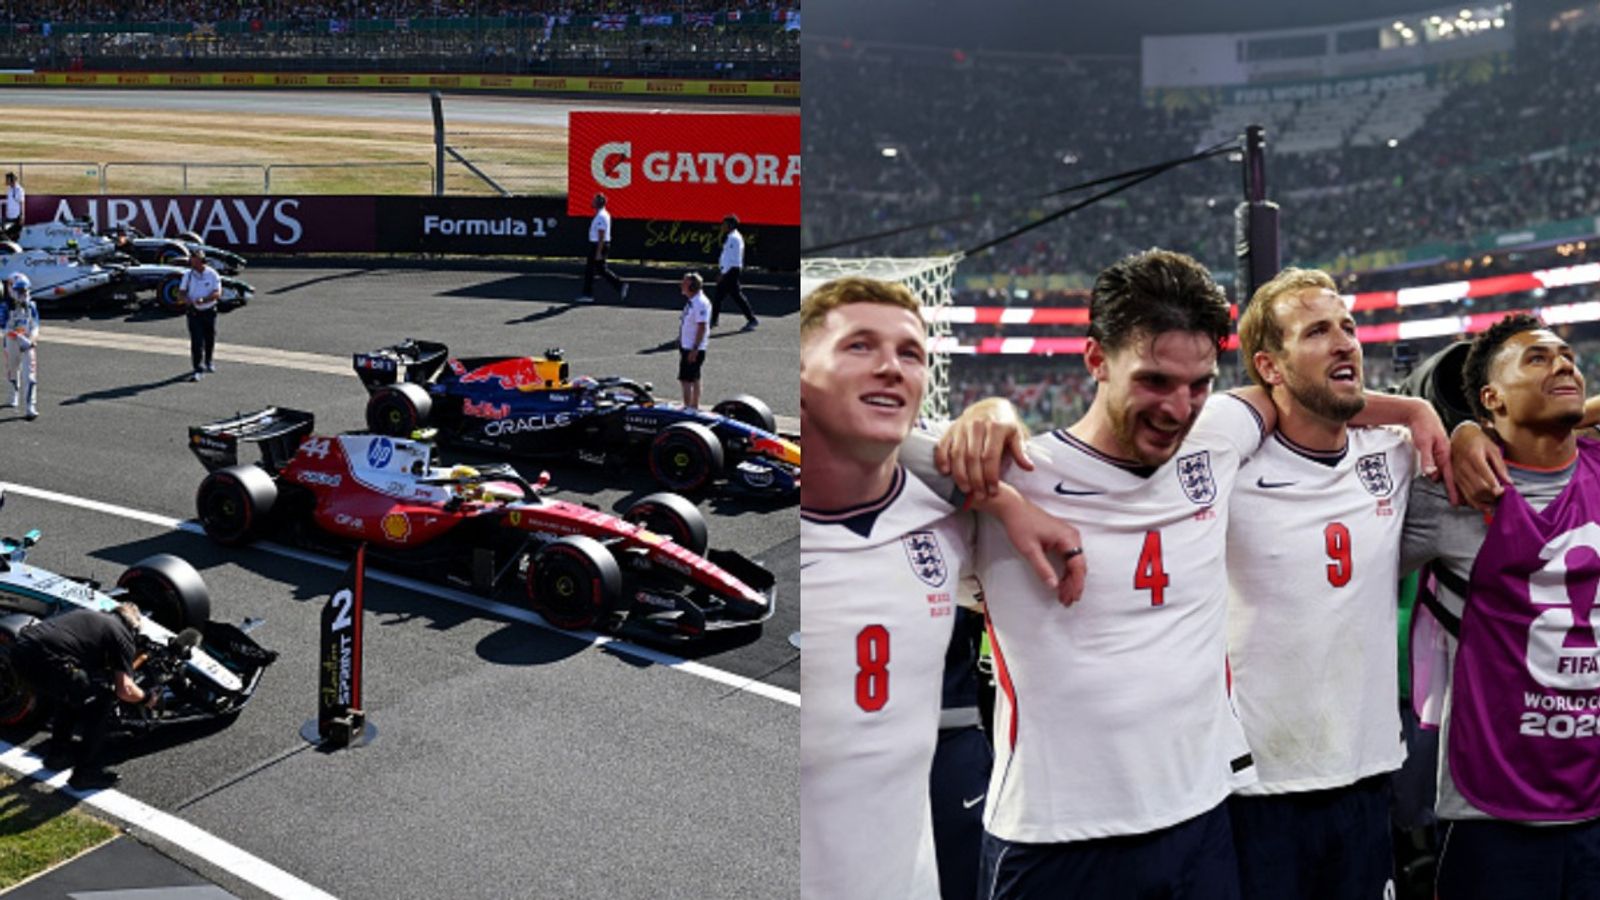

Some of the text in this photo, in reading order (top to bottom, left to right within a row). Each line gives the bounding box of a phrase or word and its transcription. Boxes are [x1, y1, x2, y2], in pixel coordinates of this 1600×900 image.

[591, 141, 800, 188] G GATORA
[51, 199, 303, 245] AIRWAYS
[424, 215, 528, 236] Formula
[485, 412, 571, 436] ORACLE
[300, 438, 330, 459] 44
[369, 438, 392, 468] hp
[1134, 529, 1170, 606] 4
[1324, 522, 1352, 588] 9
[331, 588, 353, 632] 2
[338, 633, 352, 705] SPRINT
[855, 624, 890, 713] 8
[1557, 656, 1598, 674] FIFA
[1524, 692, 1600, 711] WORLD C
